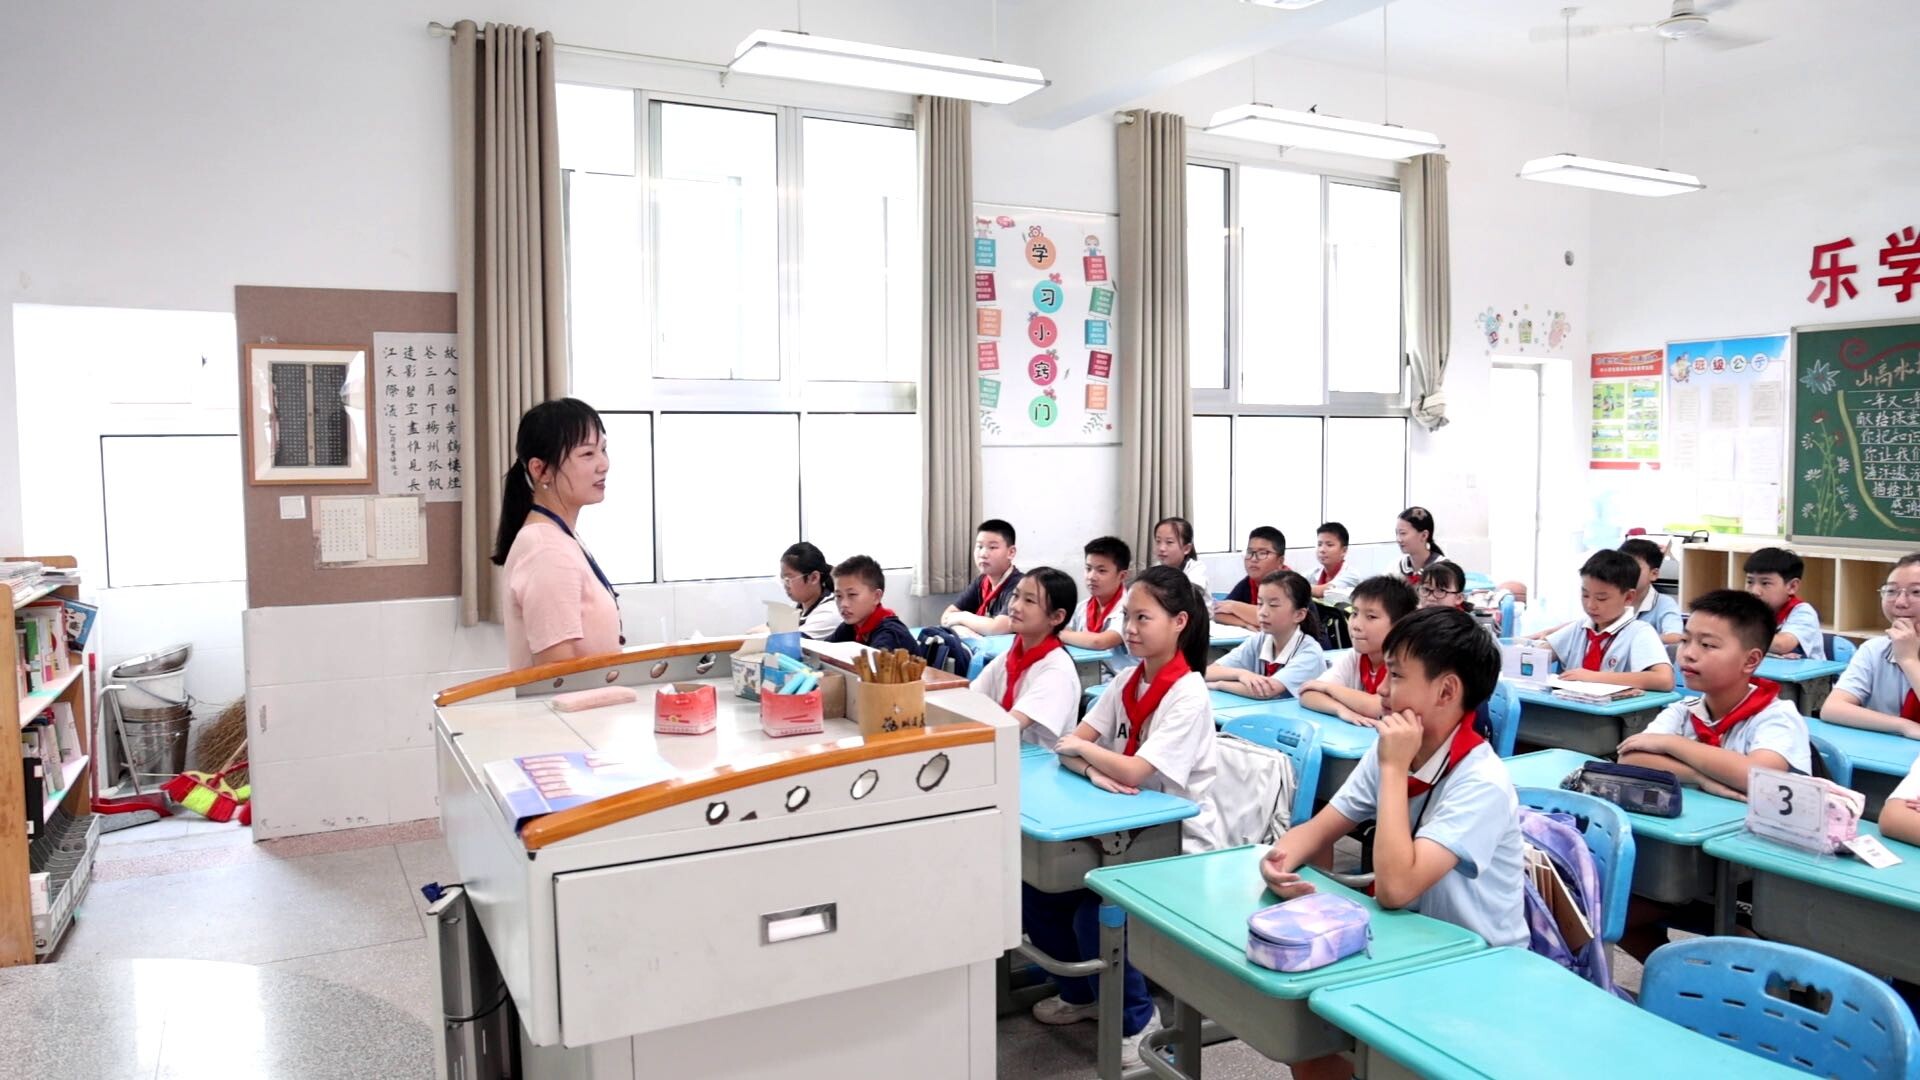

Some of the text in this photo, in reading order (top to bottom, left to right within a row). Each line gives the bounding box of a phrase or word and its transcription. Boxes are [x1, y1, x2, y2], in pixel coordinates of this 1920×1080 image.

[1806, 226, 1920, 308] 乐学
[1032, 244, 1055, 421] 学习小窍门
[1855, 352, 1920, 388] 山高水
[1872, 481, 1920, 498] 描绘出
[1778, 785, 1794, 816] 3
